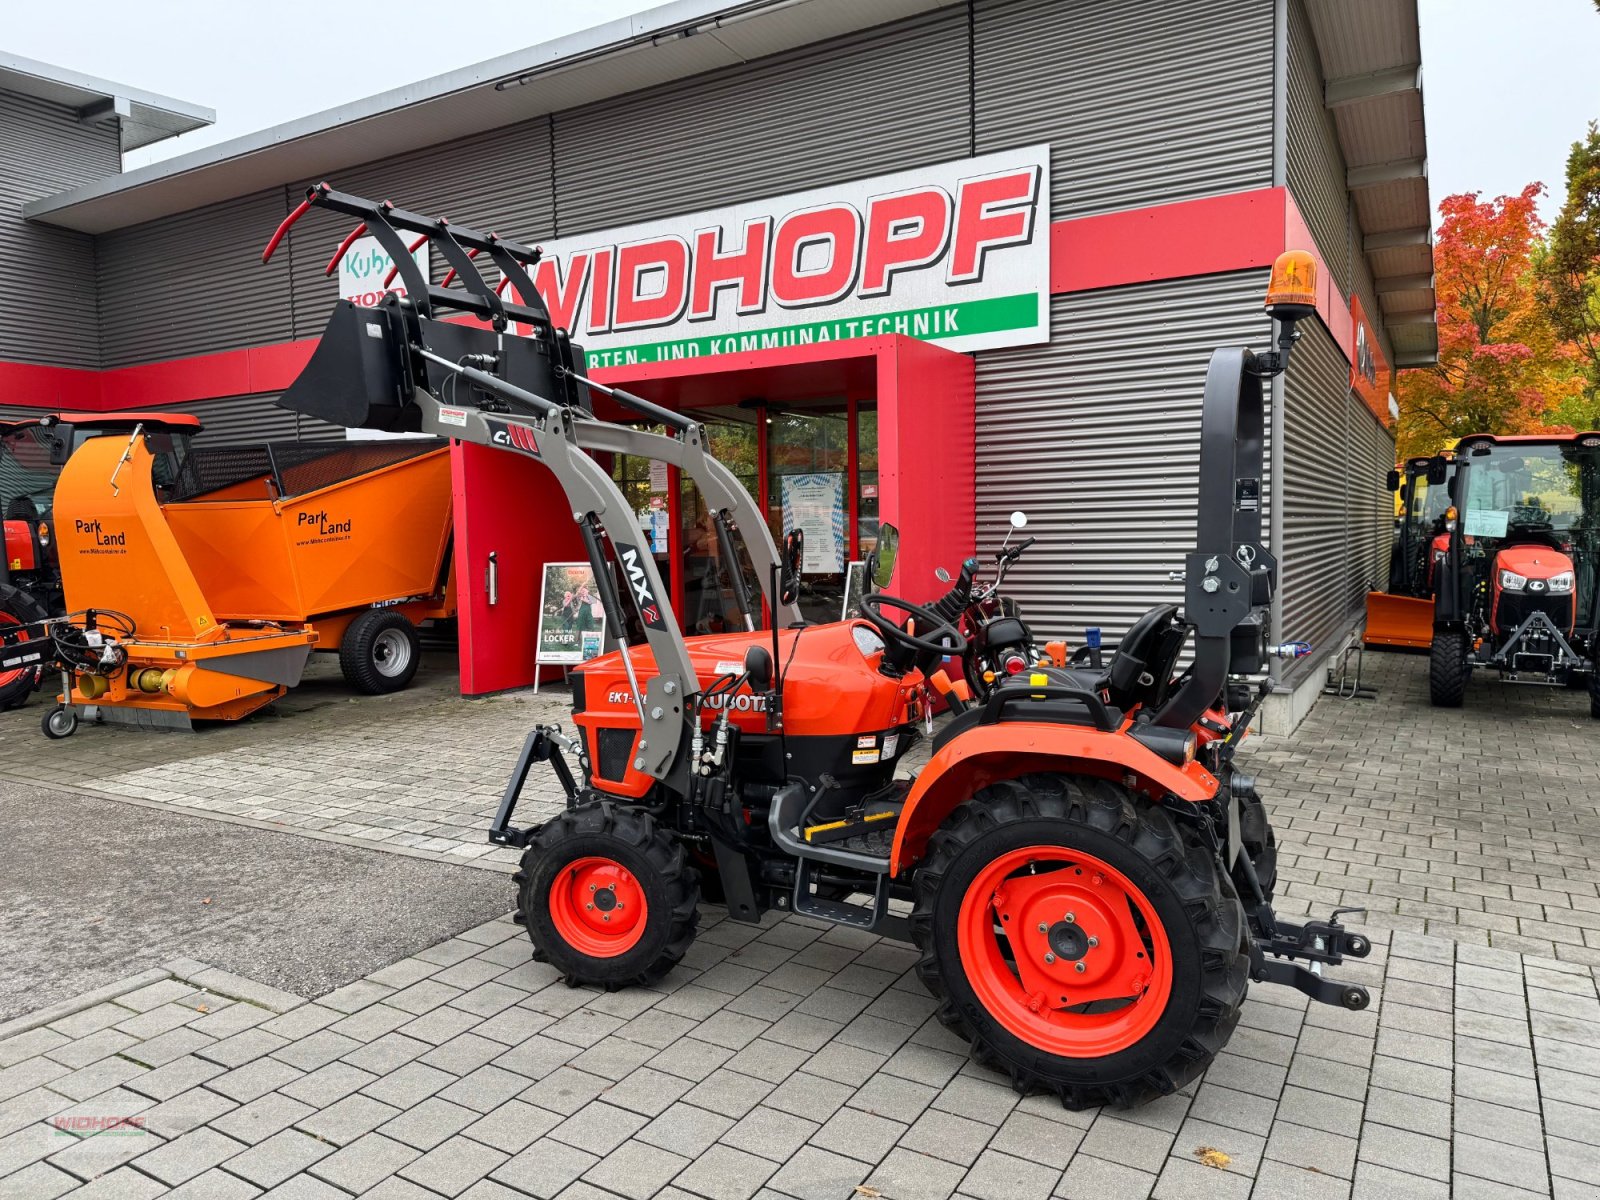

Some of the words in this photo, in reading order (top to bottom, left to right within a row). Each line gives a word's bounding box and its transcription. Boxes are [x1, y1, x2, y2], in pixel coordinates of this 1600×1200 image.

[507, 163, 1043, 338] WIDHOPF
[75, 518, 103, 533] Park
[298, 510, 328, 526] Park
[320, 518, 351, 535] Land
[96, 530, 126, 546] Land
[622, 548, 654, 606] MX
[544, 634, 575, 643] LOCKER
